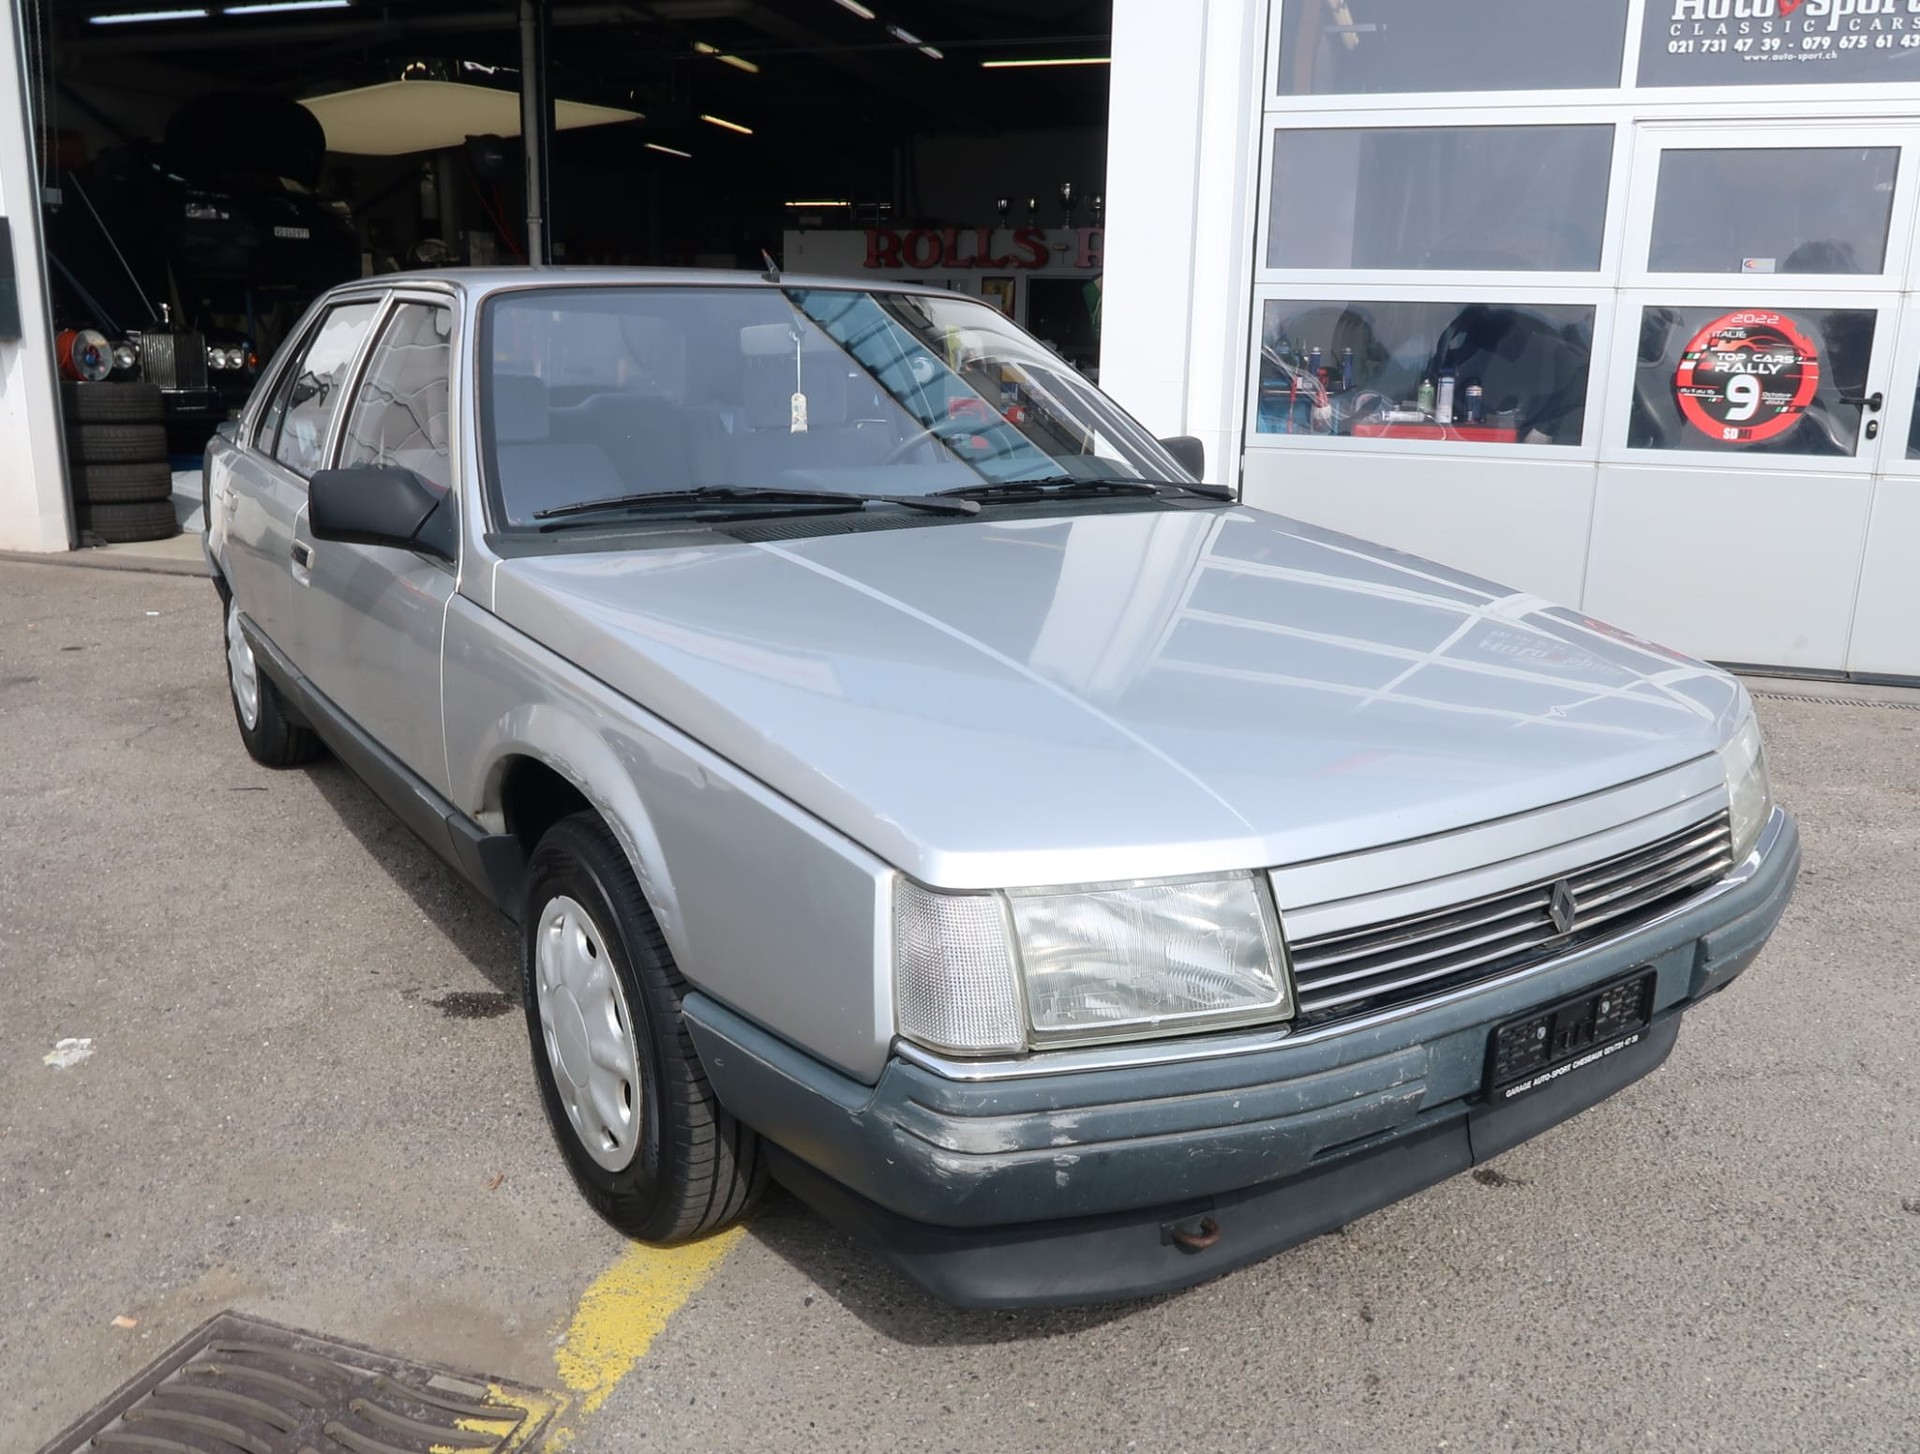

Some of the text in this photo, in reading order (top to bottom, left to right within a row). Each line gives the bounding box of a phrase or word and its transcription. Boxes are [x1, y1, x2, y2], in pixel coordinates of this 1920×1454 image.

[1669, 17, 1920, 36] CLASSIC CARS
[1668, 40, 1694, 53] 021
[1701, 39, 1727, 52] 731
[1733, 38, 1753, 51] 47
[1761, 38, 1780, 51] 39
[1802, 36, 1831, 50] 079
[1839, 35, 1867, 48] 675
[1875, 34, 1893, 48] 61
[1900, 34, 1920, 47] 43
[1743, 50, 1838, 62] www.auto-sport.ch
[1731, 314, 1780, 324] 2022
[1711, 330, 1747, 339] ITALIE
[1717, 353, 1795, 364] TOP CARS
[1714, 362, 1783, 375] RALLY
[1725, 374, 1760, 421] 9
[1506, 1081, 1532, 1097] GARAGE
[1533, 1064, 1571, 1087] AUTO-SPORT
